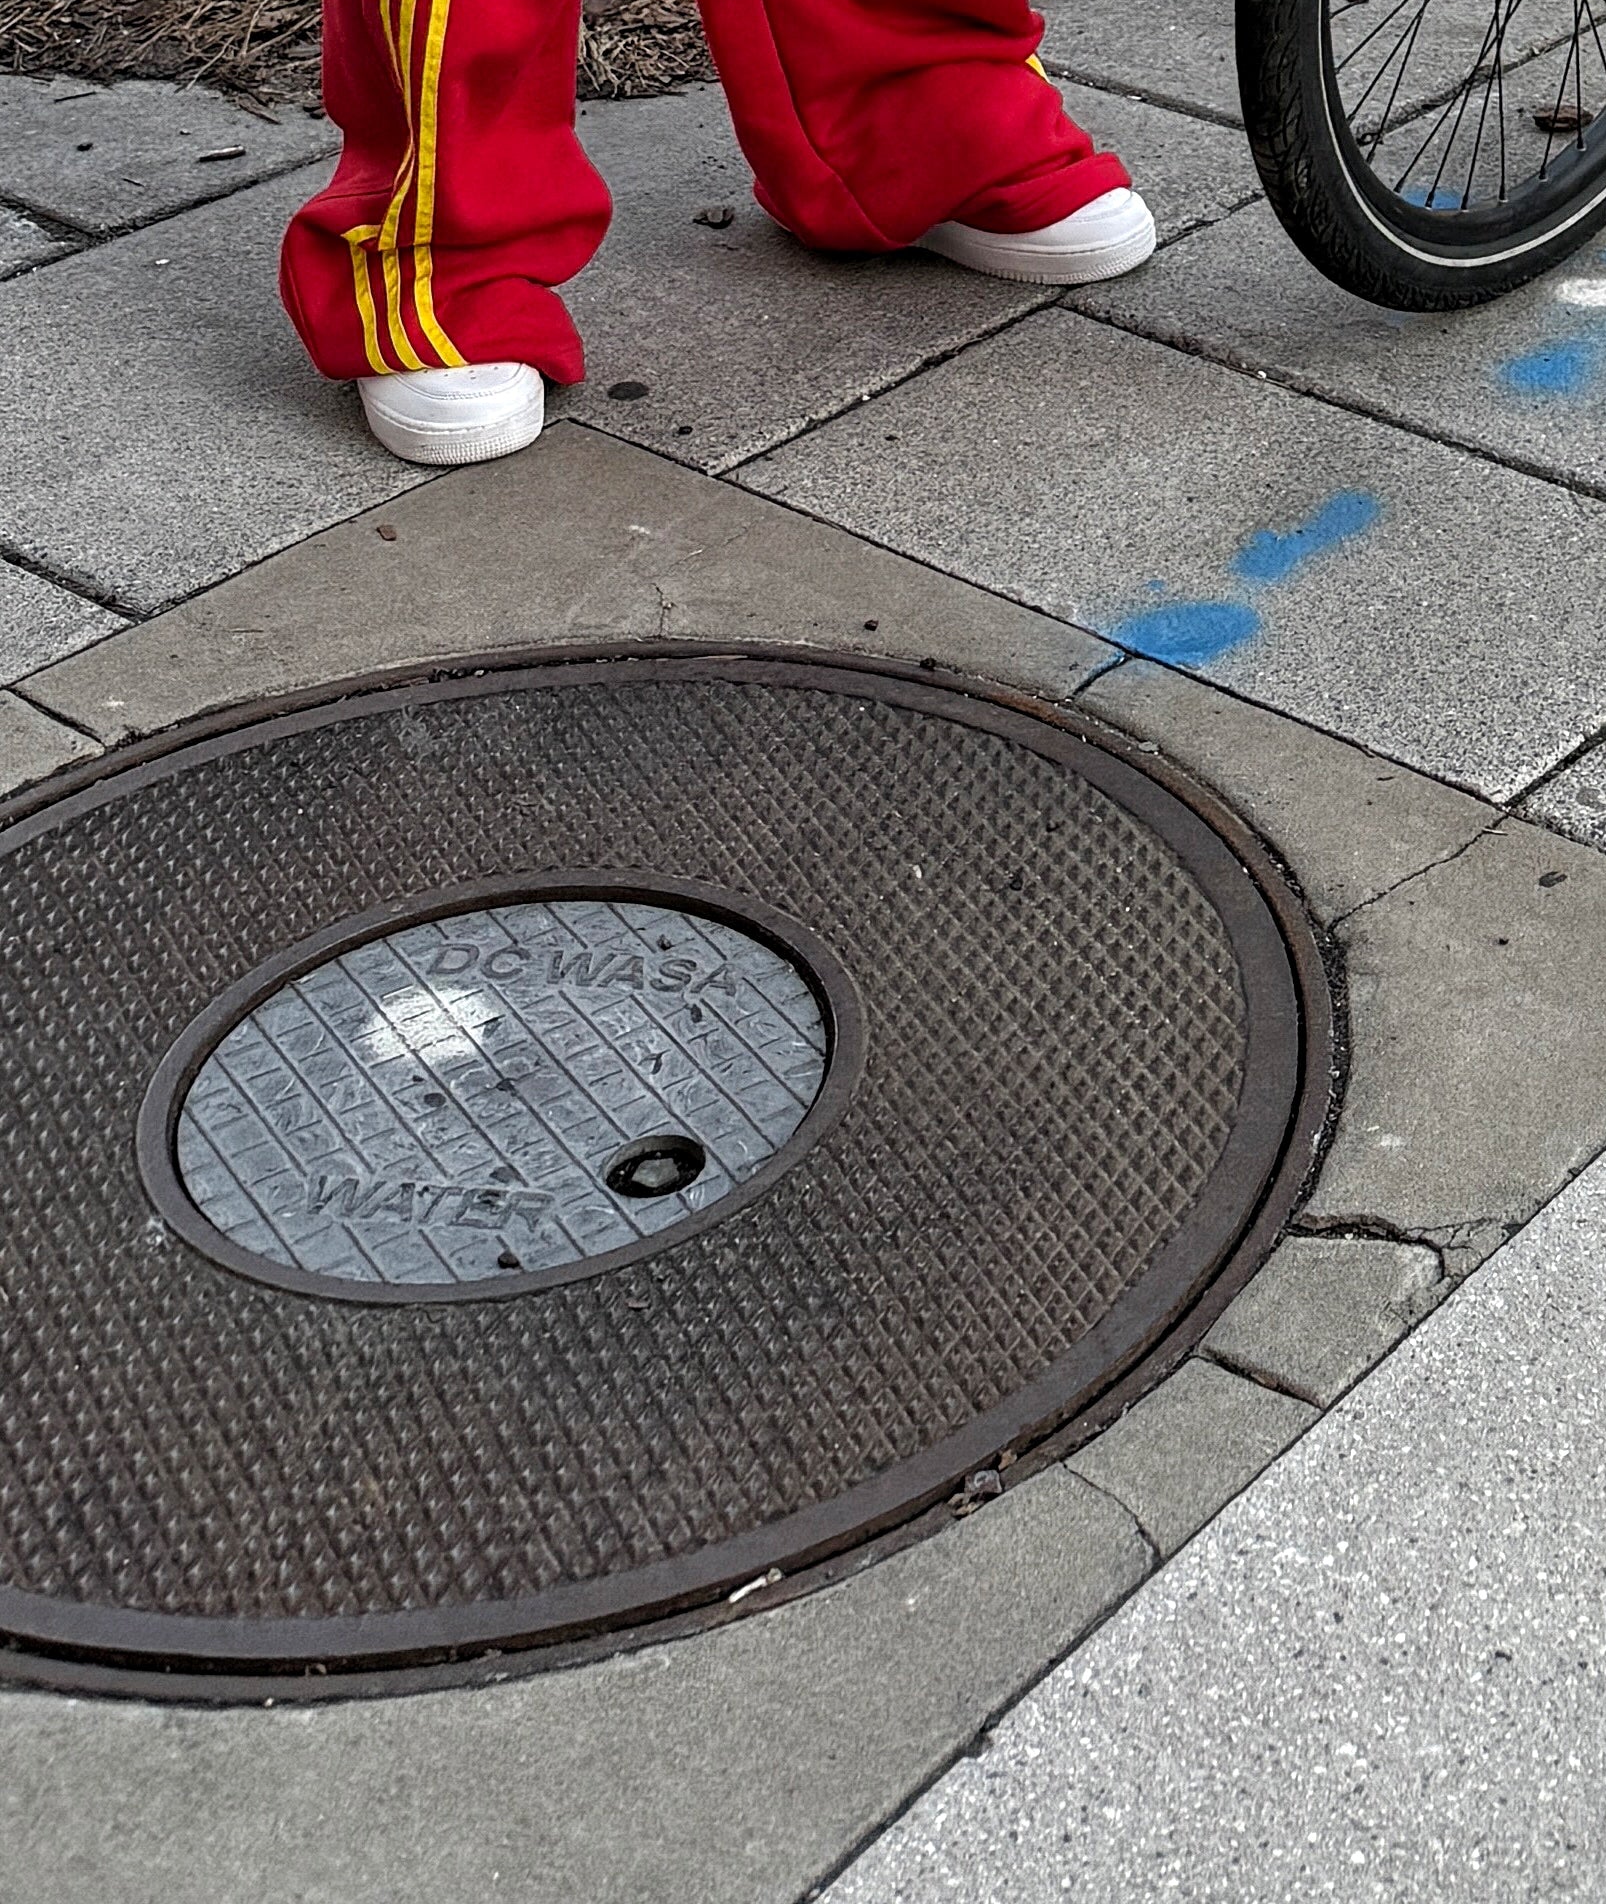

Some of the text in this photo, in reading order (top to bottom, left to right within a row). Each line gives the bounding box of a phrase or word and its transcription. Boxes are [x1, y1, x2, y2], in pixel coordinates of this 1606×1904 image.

[426, 943, 738, 997] DC WASA
[305, 1174, 556, 1234] WATER
